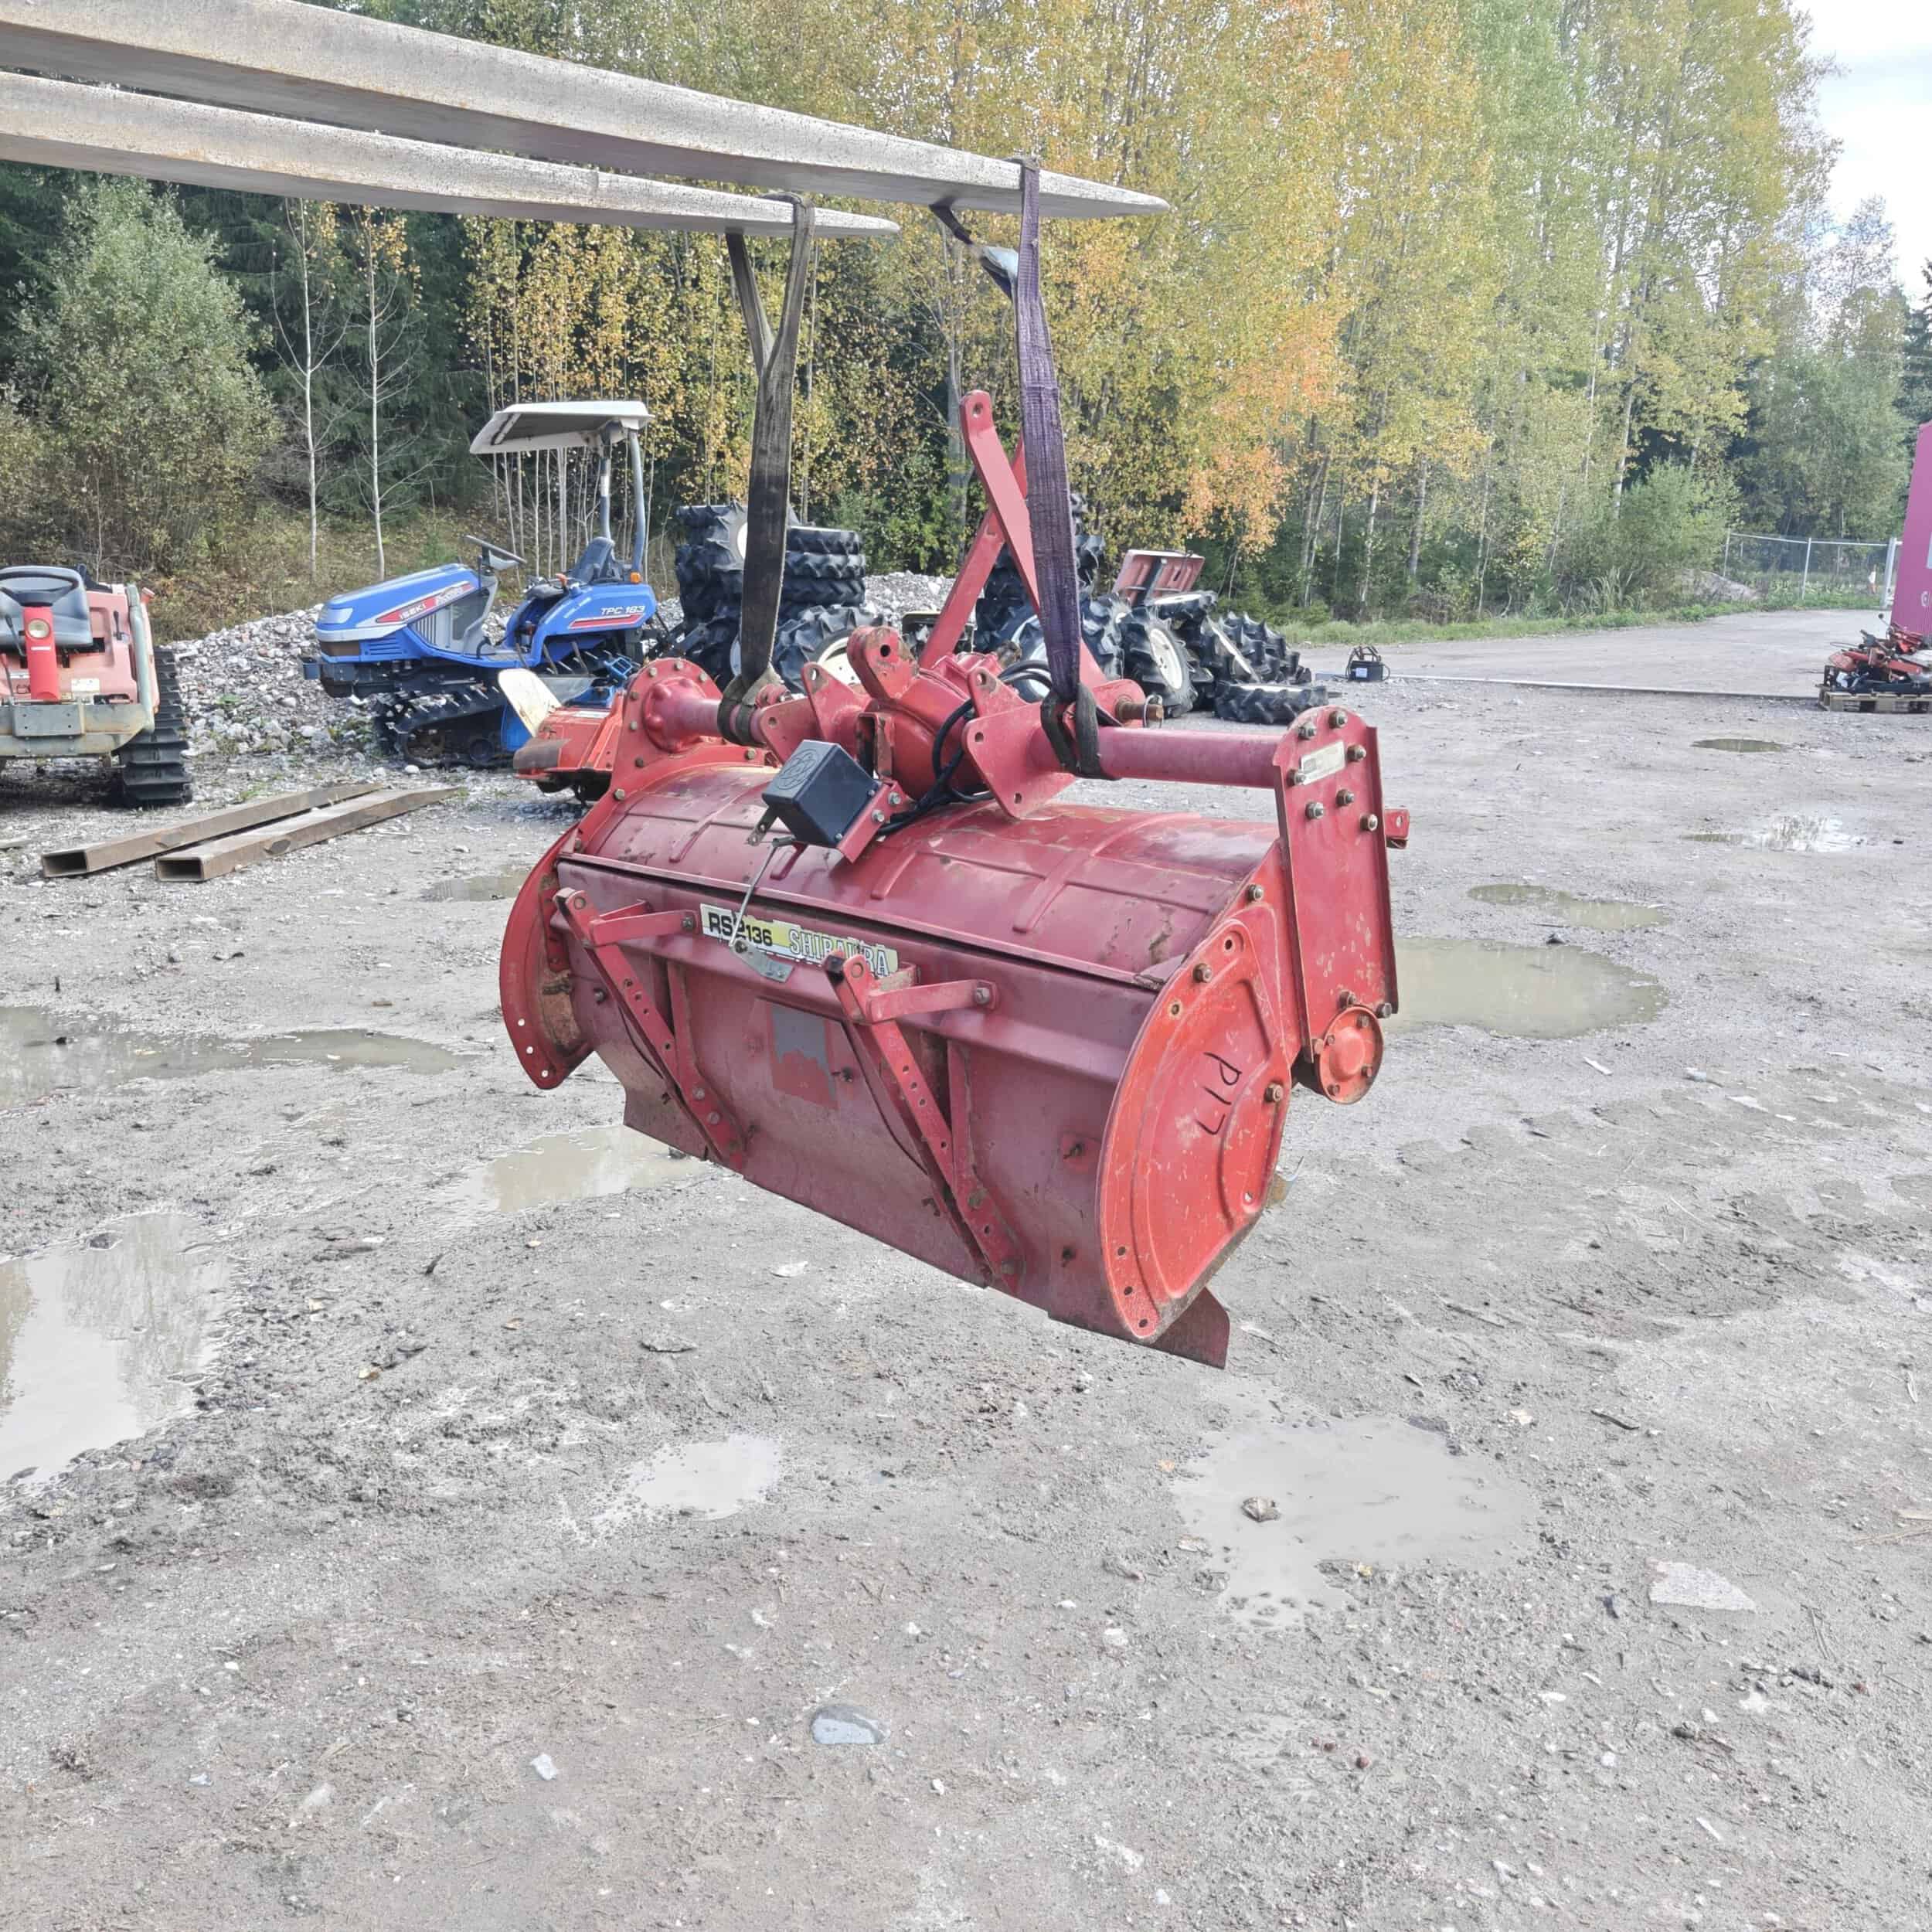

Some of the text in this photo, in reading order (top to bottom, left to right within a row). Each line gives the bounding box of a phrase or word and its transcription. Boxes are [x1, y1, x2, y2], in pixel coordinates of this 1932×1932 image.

[399, 603, 426, 620] ISEKI
[600, 605, 645, 615] TPC 183
[708, 912, 772, 947] RS2136
